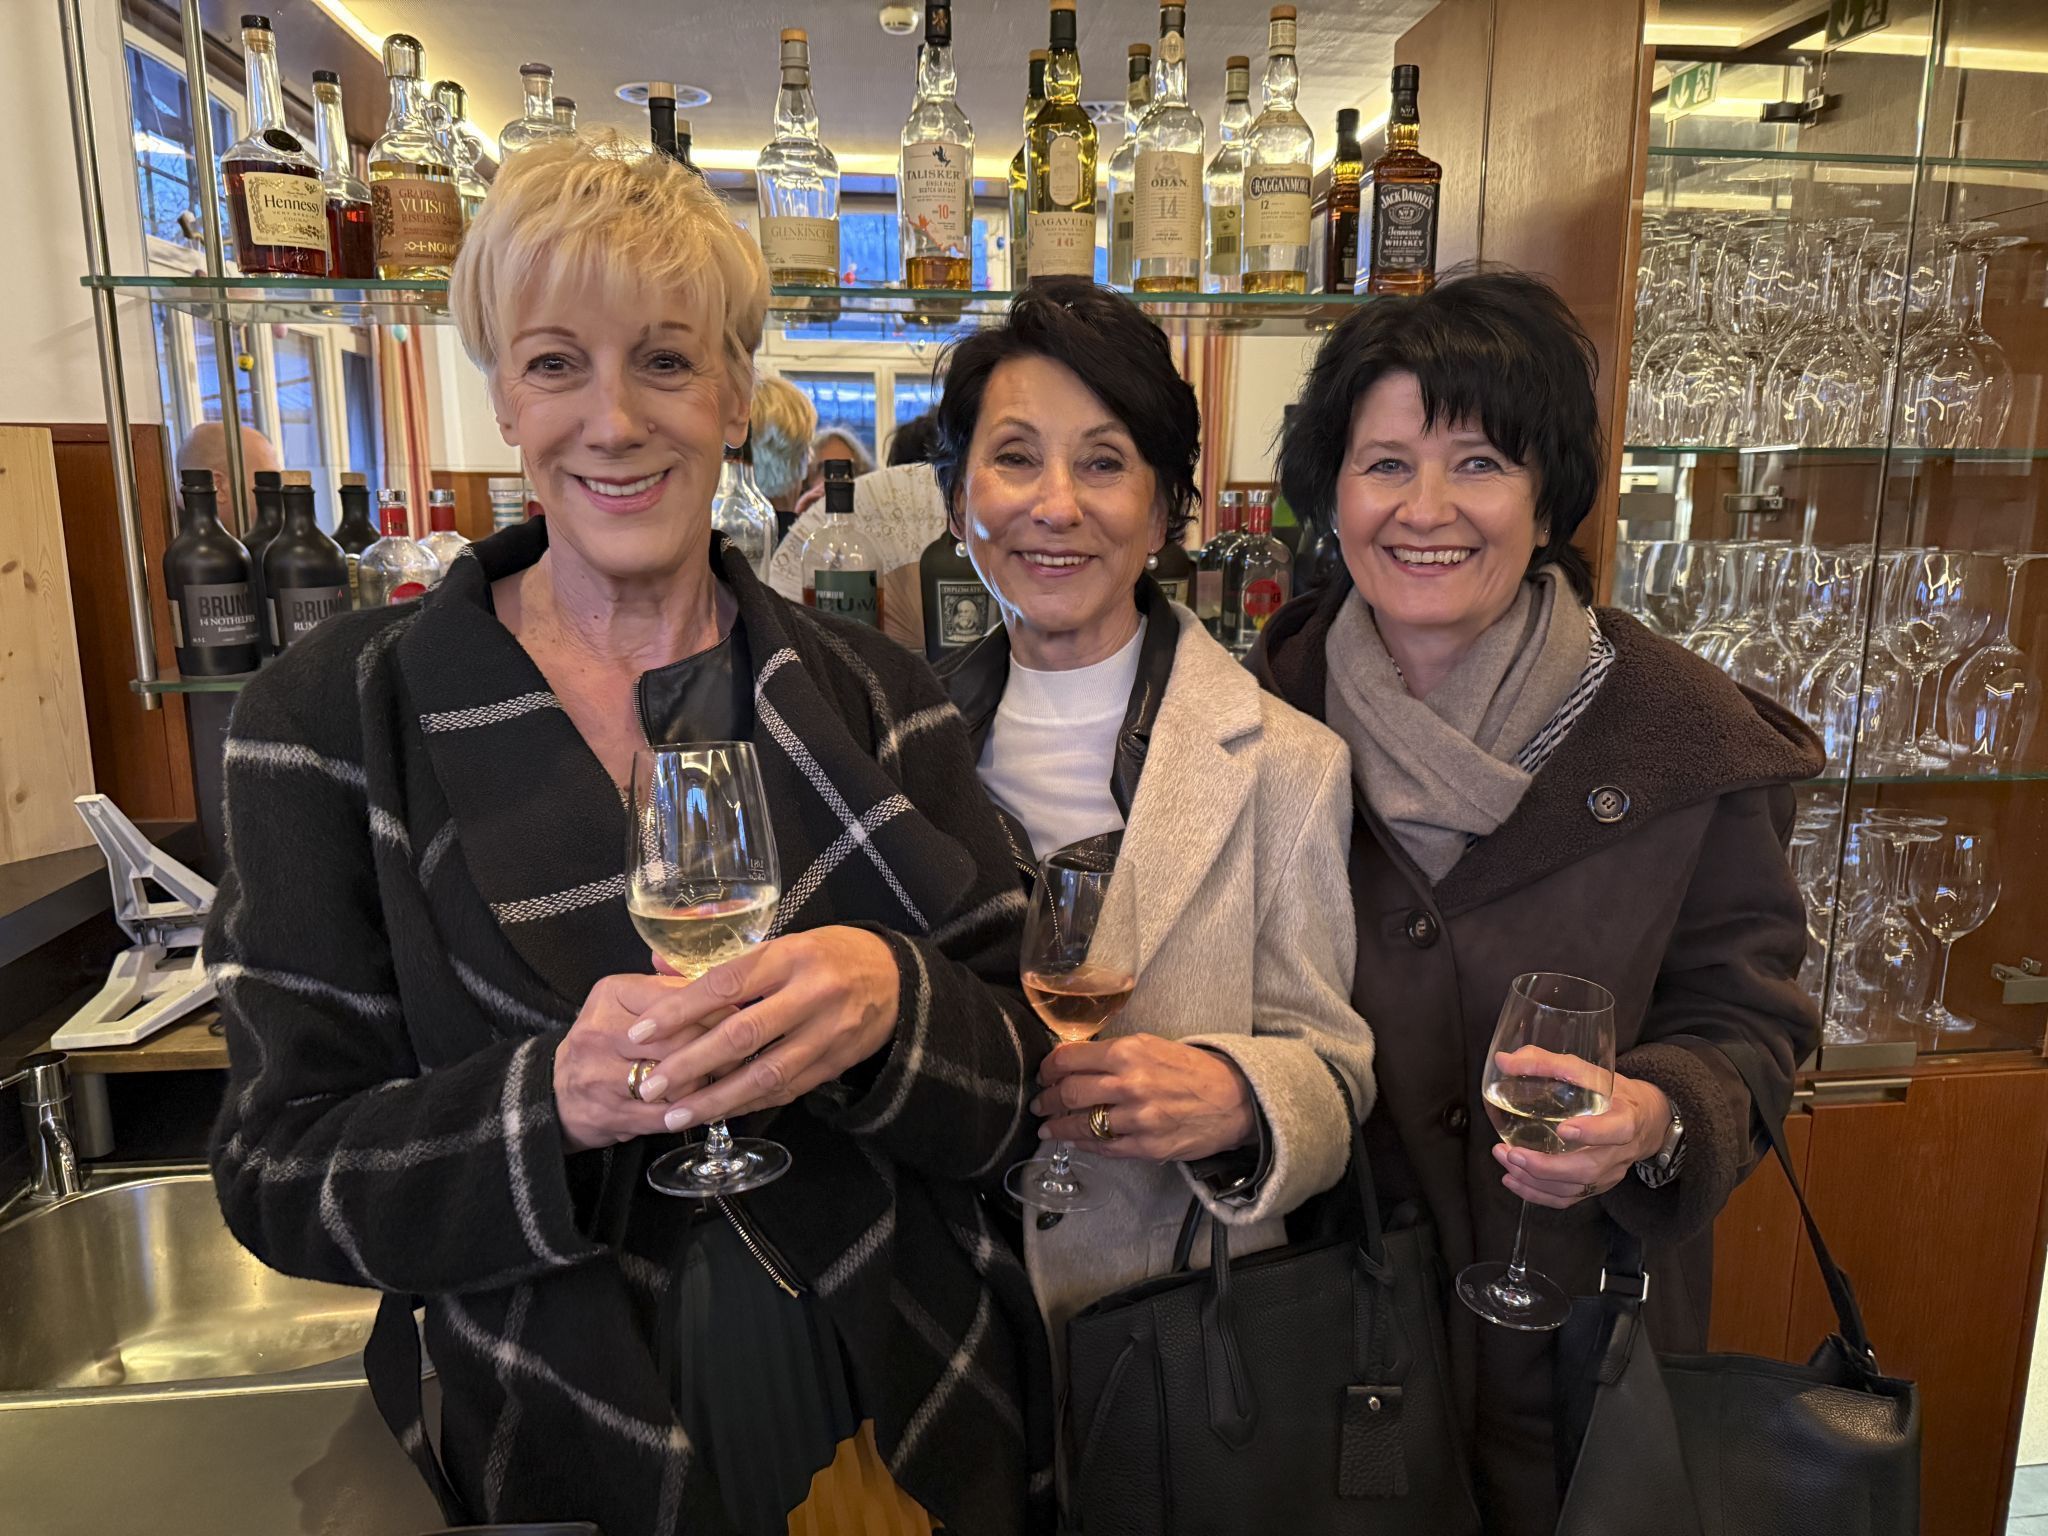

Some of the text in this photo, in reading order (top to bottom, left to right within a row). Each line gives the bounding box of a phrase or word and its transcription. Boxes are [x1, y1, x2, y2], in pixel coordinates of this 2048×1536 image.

[907, 169, 960, 181] TALISKER
[1151, 179, 1188, 188] OBAN
[398, 188, 437, 200] GRAPPA
[1380, 188, 1435, 210] JACK DANIEL'S
[264, 194, 321, 217] Hennessy
[1158, 196, 1178, 219] 14
[1260, 200, 1269, 210] 12
[938, 204, 949, 219] 10
[1385, 239, 1424, 247] WHISKEY
